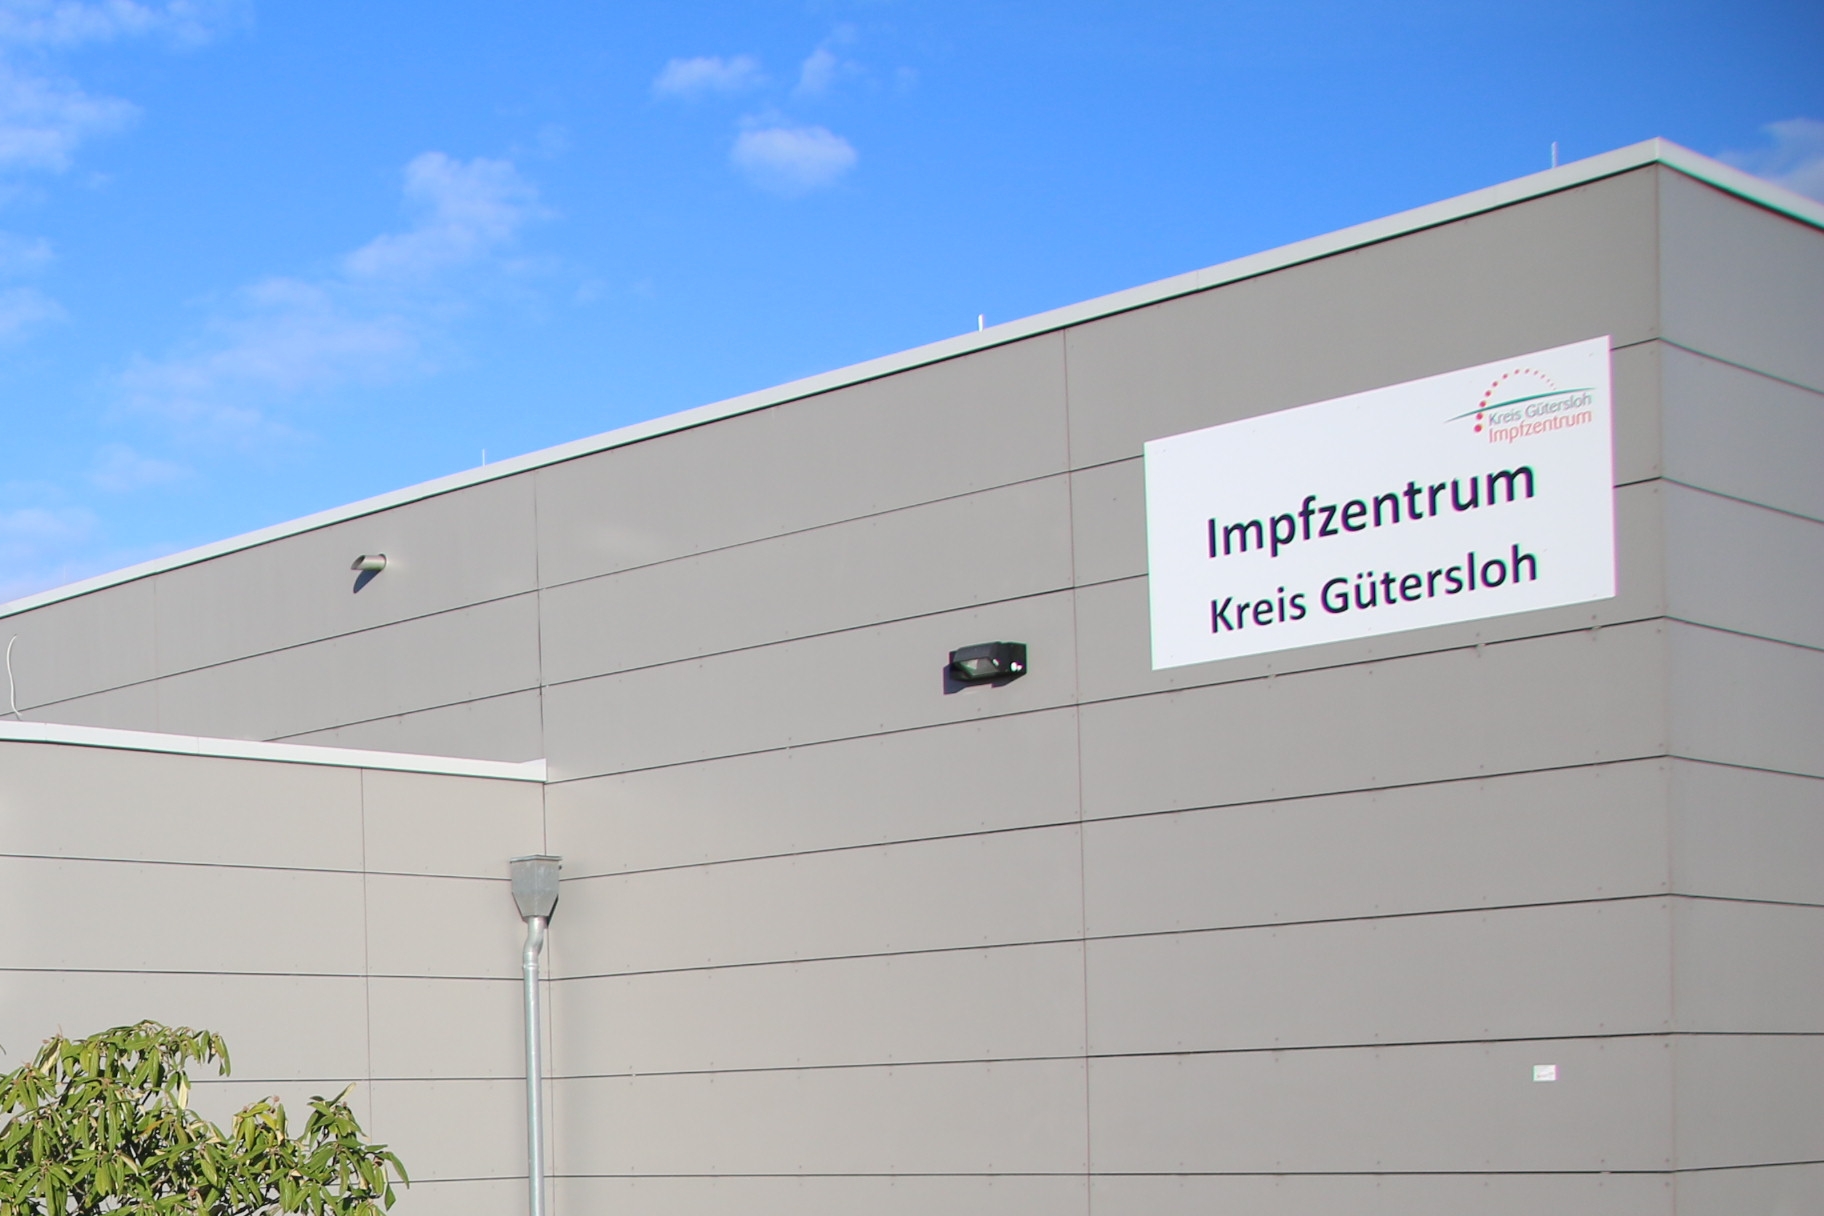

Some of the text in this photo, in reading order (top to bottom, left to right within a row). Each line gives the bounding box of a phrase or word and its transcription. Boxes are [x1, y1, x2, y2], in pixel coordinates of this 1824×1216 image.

[1488, 392, 1593, 426] Kreis Gütersloh
[1488, 410, 1593, 444] Impfzentrum
[1207, 463, 1536, 559] Impfzentrum
[1210, 543, 1539, 634] Kreis Gütersloh
